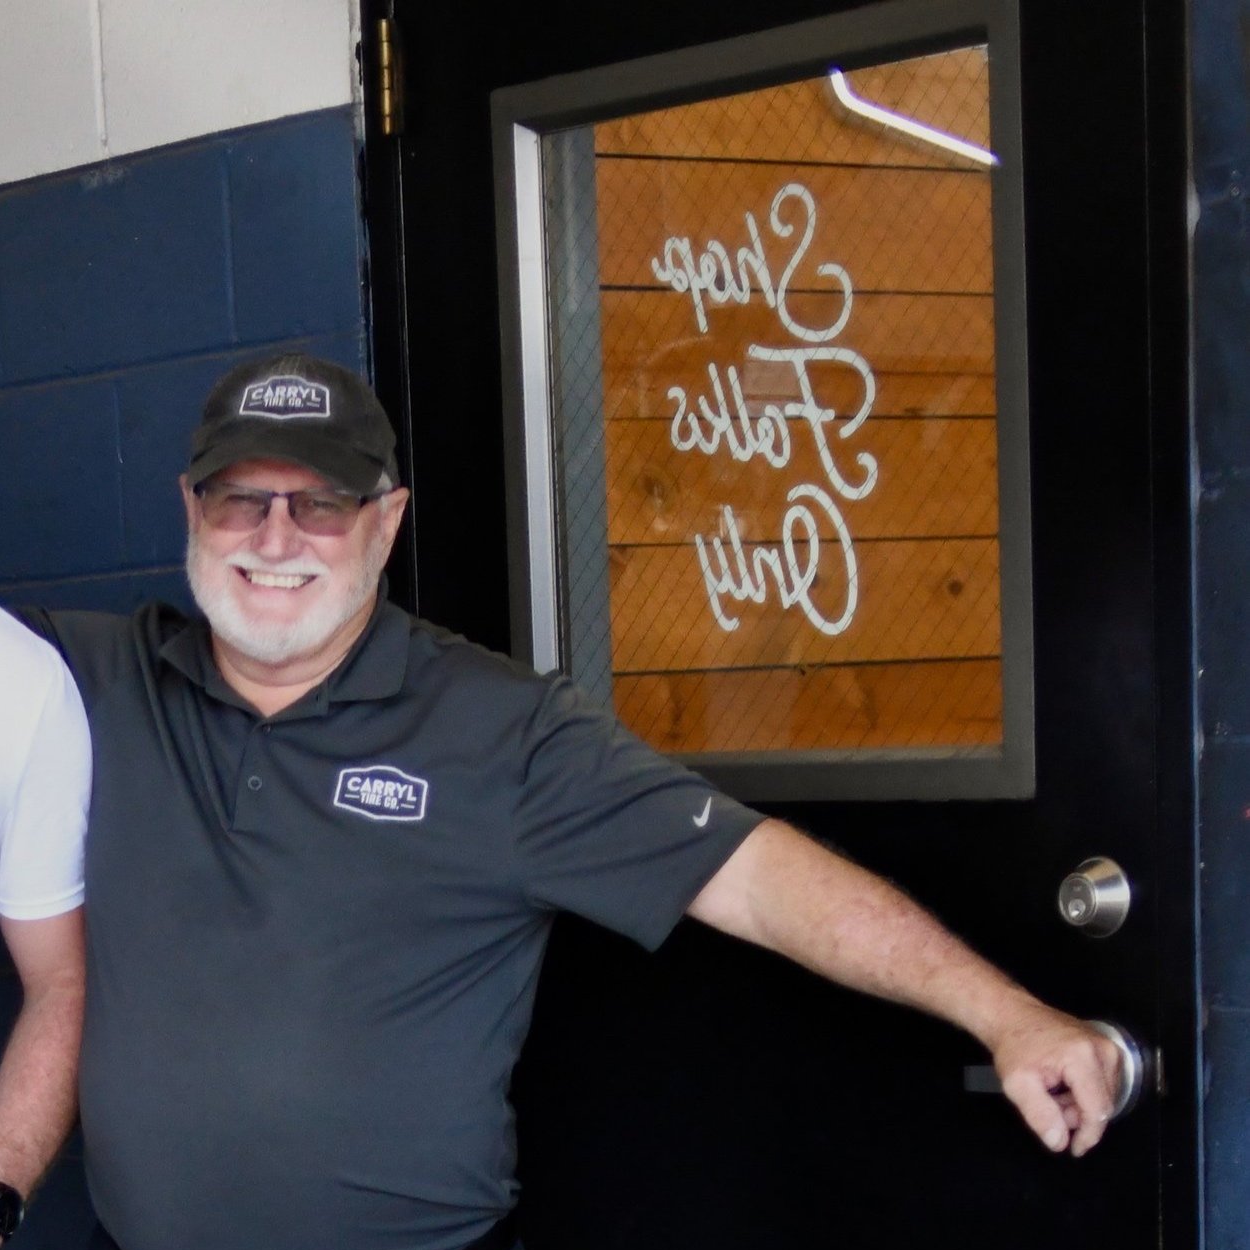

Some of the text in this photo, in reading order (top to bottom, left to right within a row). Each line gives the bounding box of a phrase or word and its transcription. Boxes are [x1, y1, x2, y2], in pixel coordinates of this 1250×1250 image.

[251, 384, 322, 403] CARRYL
[346, 776, 417, 801] CARRYL
[360, 792, 382, 806] TIRE
